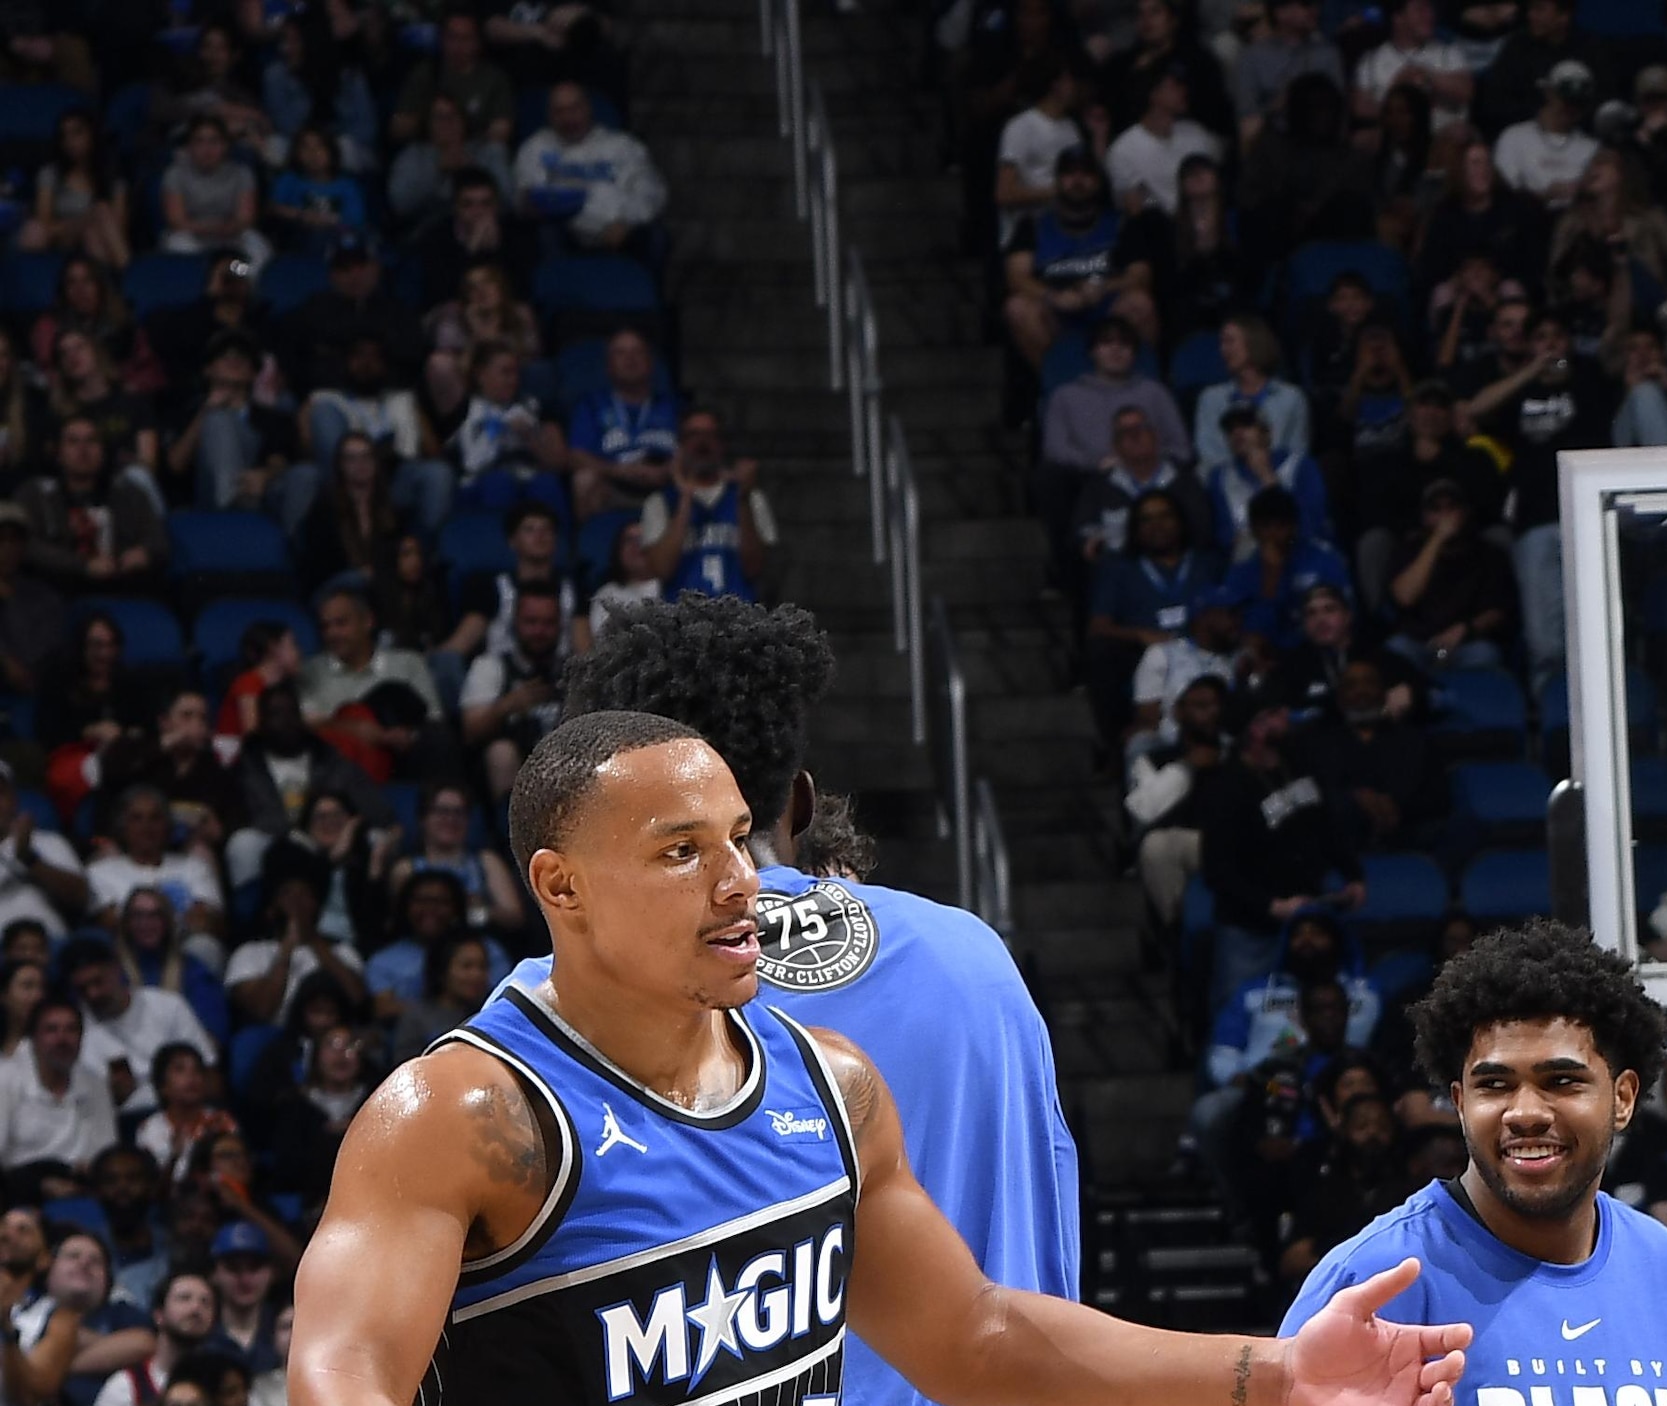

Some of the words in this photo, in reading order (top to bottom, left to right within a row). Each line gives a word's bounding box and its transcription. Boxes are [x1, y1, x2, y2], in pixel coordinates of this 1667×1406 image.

[765, 899, 829, 951] 75
[847, 902, 869, 949] LLOYD
[755, 958, 787, 980] PER
[796, 951, 862, 984] CLIFTON
[1506, 1358, 1606, 1376] BUILT
[1630, 1359, 1664, 1378] BY
